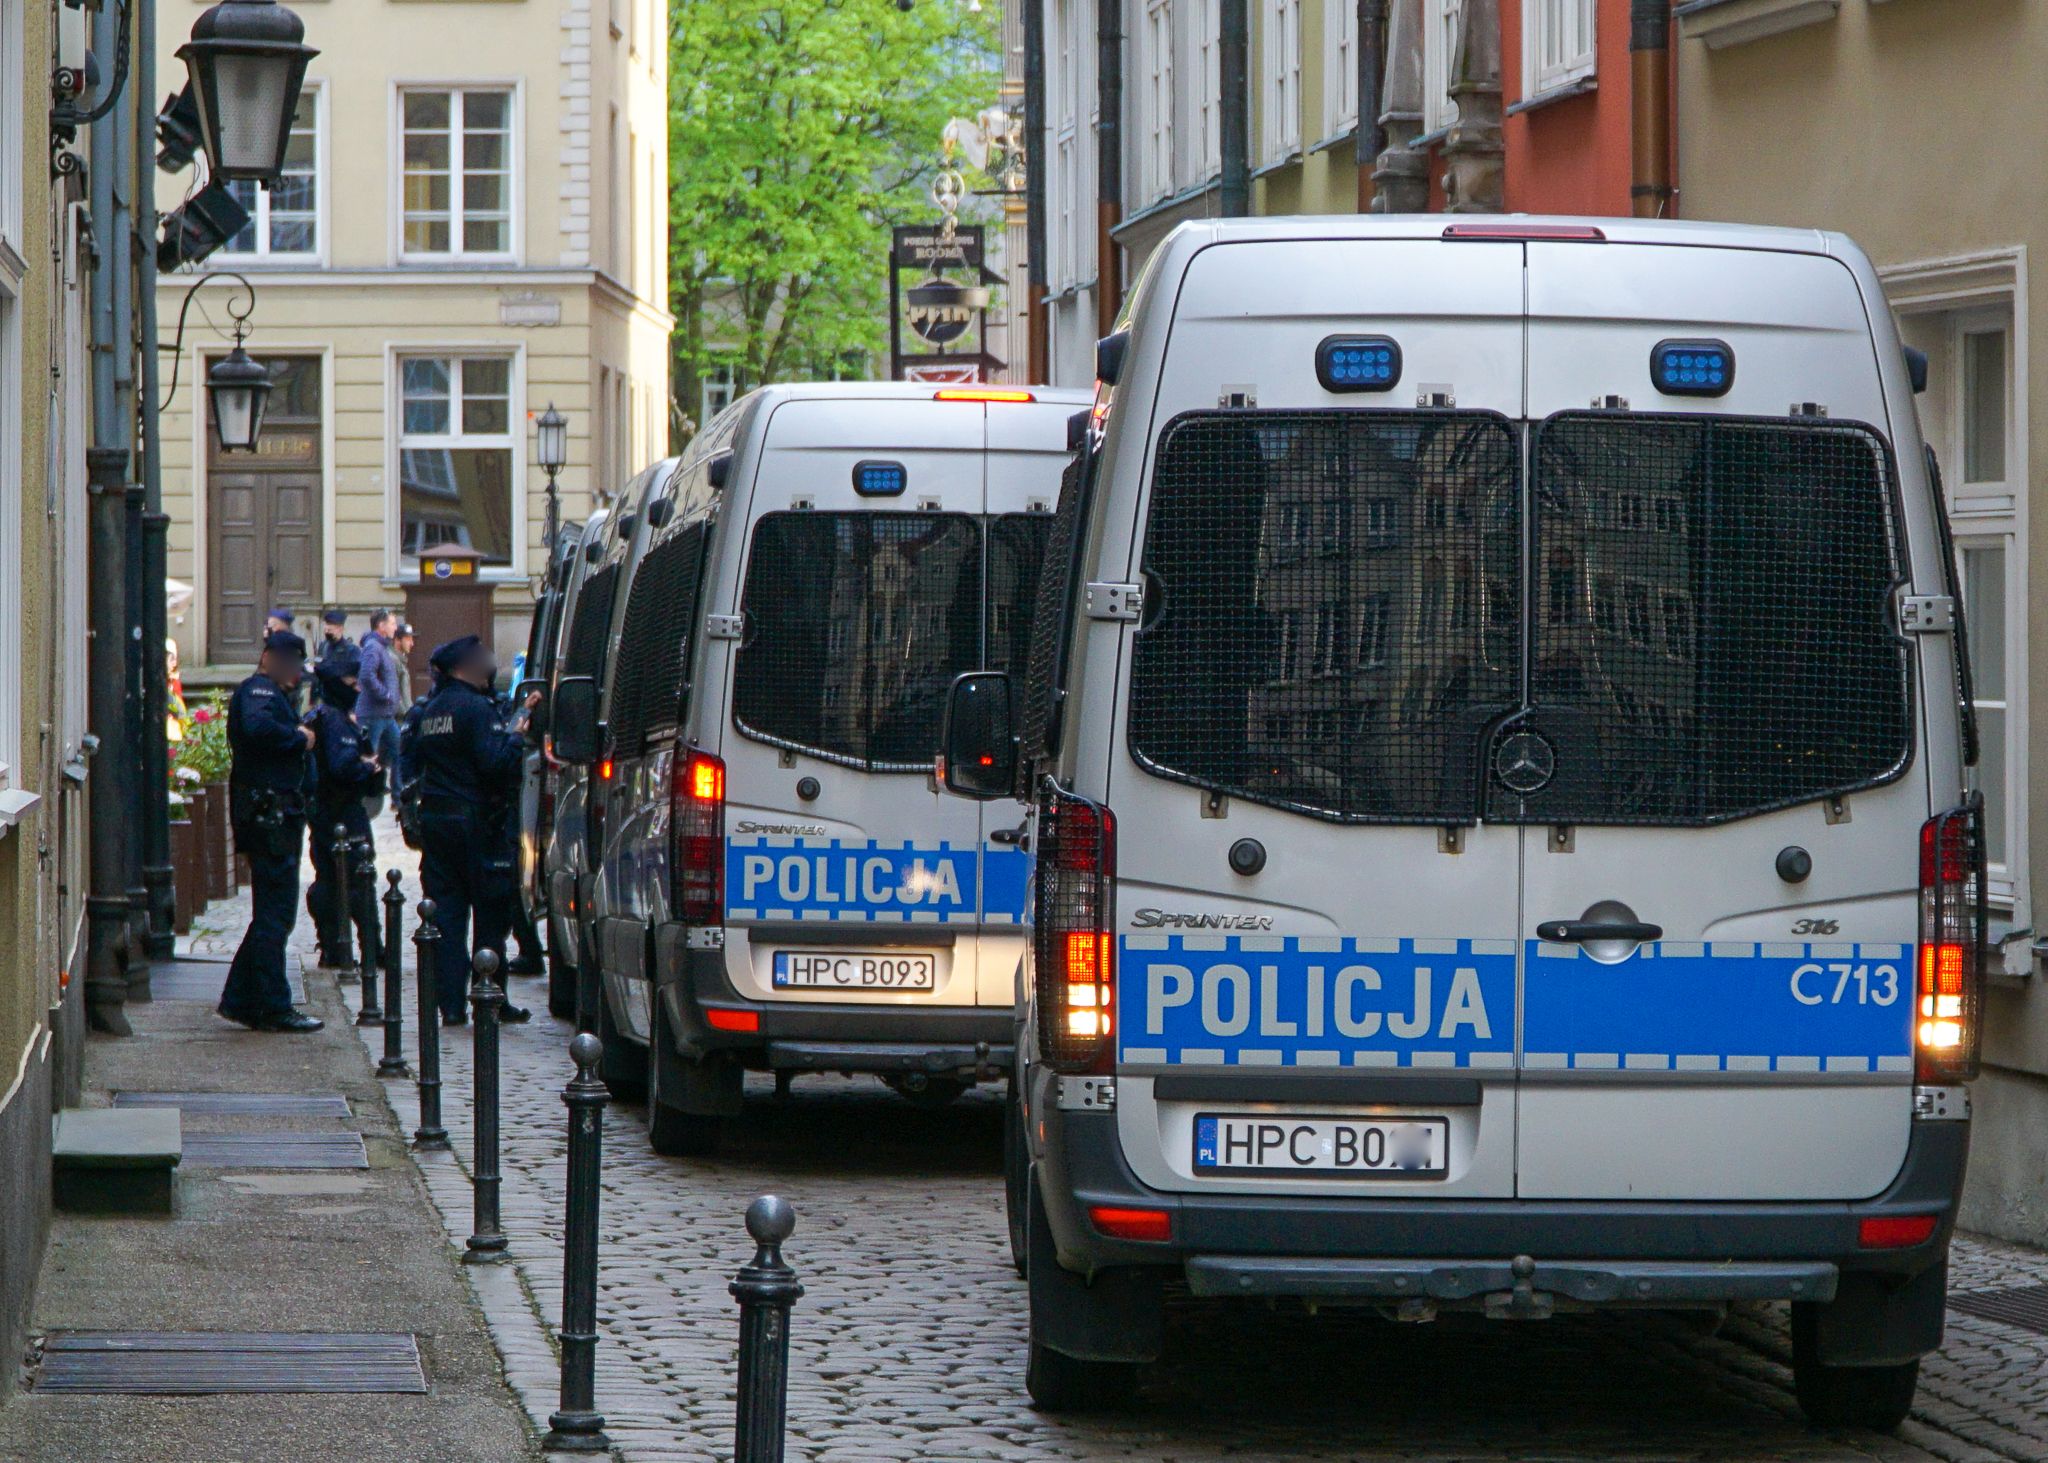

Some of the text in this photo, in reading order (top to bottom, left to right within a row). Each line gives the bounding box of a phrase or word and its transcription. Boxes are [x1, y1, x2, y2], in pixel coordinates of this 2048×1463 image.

[743, 855, 962, 905] POLICJA
[1130, 907, 1274, 931] SPRINTER
[1791, 918, 1840, 936] 316
[792, 957, 928, 986] HPC B093
[1790, 963, 1899, 1007] C713
[1146, 963, 1492, 1039] POLICJA
[1199, 1149, 1216, 1162] PL
[1225, 1123, 1433, 1169] HPC B0
